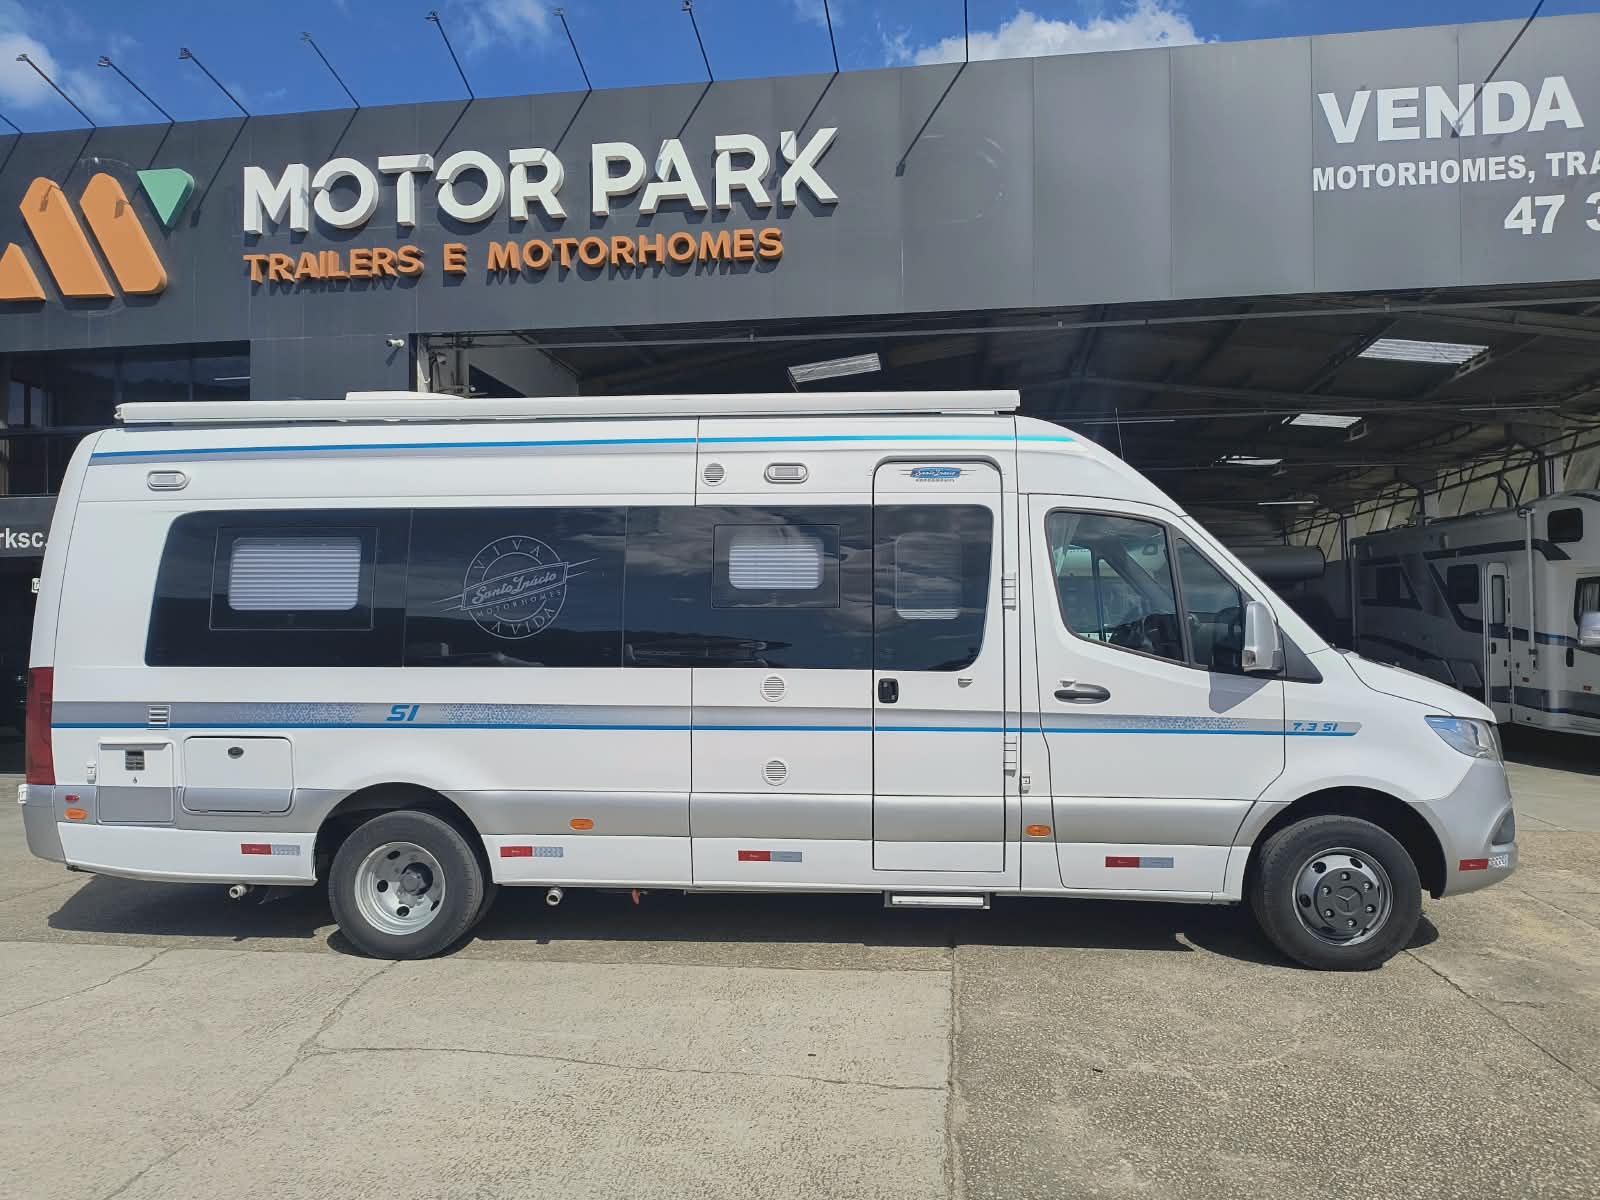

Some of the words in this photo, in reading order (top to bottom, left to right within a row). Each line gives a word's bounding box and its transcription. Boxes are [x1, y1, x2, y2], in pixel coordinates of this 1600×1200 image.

[1317, 75, 1585, 144] VENDA
[243, 148, 568, 235] MOTOR
[591, 127, 839, 216] PARK
[1312, 154, 1536, 192] MOTORHOMES,
[1503, 194, 1566, 235] 47
[243, 244, 425, 284] TRAILERS
[443, 242, 467, 274] E
[486, 227, 784, 272] MOTORHOMES
[473, 539, 541, 569] VIVA
[471, 583, 513, 605] Santo
[386, 704, 420, 721] SI
[1293, 722, 1318, 731] 7.3
[1321, 722, 1338, 731] SI
